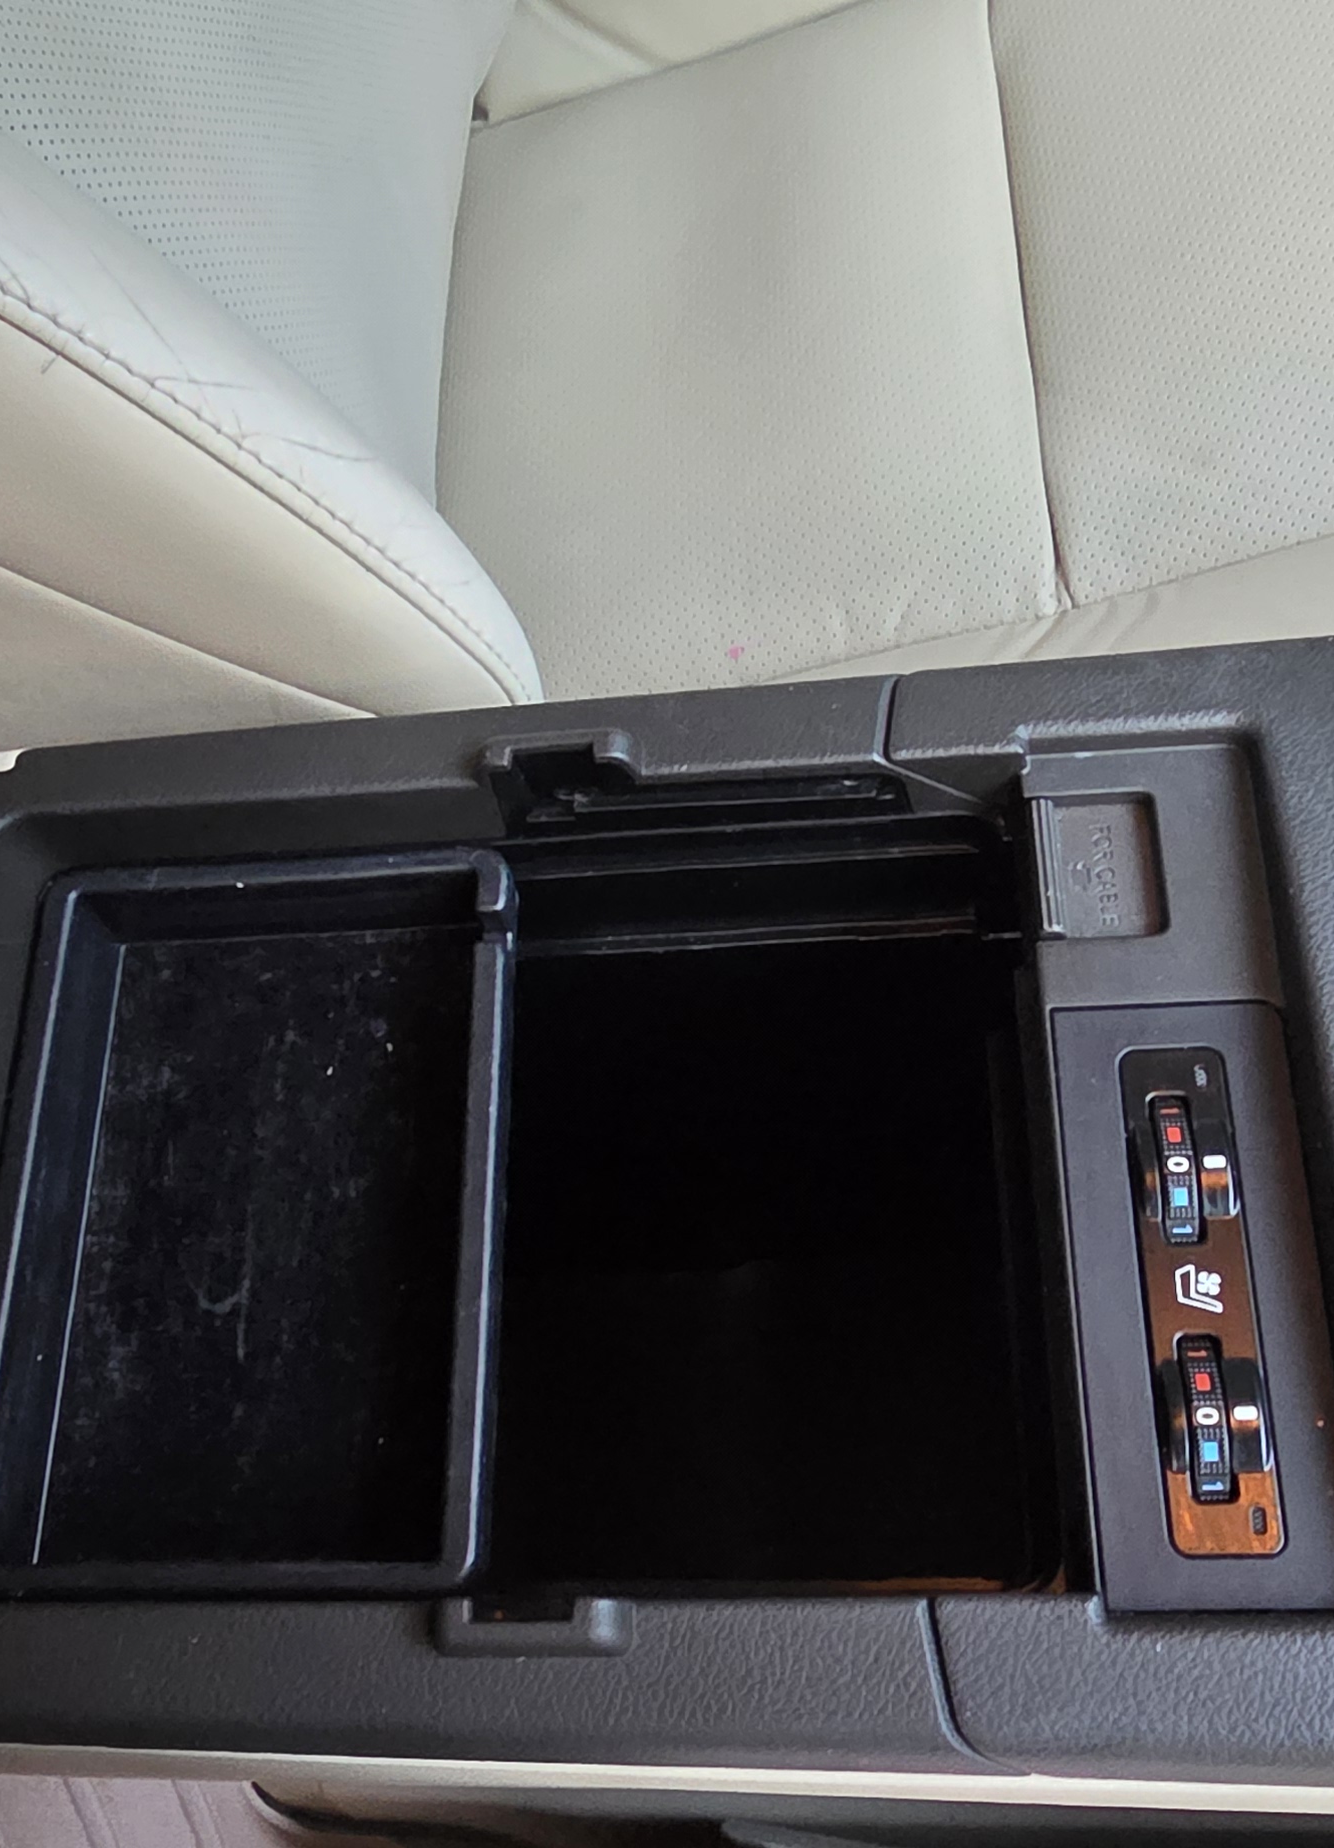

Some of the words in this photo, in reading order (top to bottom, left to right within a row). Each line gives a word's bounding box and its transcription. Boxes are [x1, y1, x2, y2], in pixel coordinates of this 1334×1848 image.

[1089, 823, 1114, 861] FOR
[1094, 866, 1121, 927] CABLE
[1166, 1155, 1190, 1173] 0
[1195, 1406, 1220, 1426] 0
